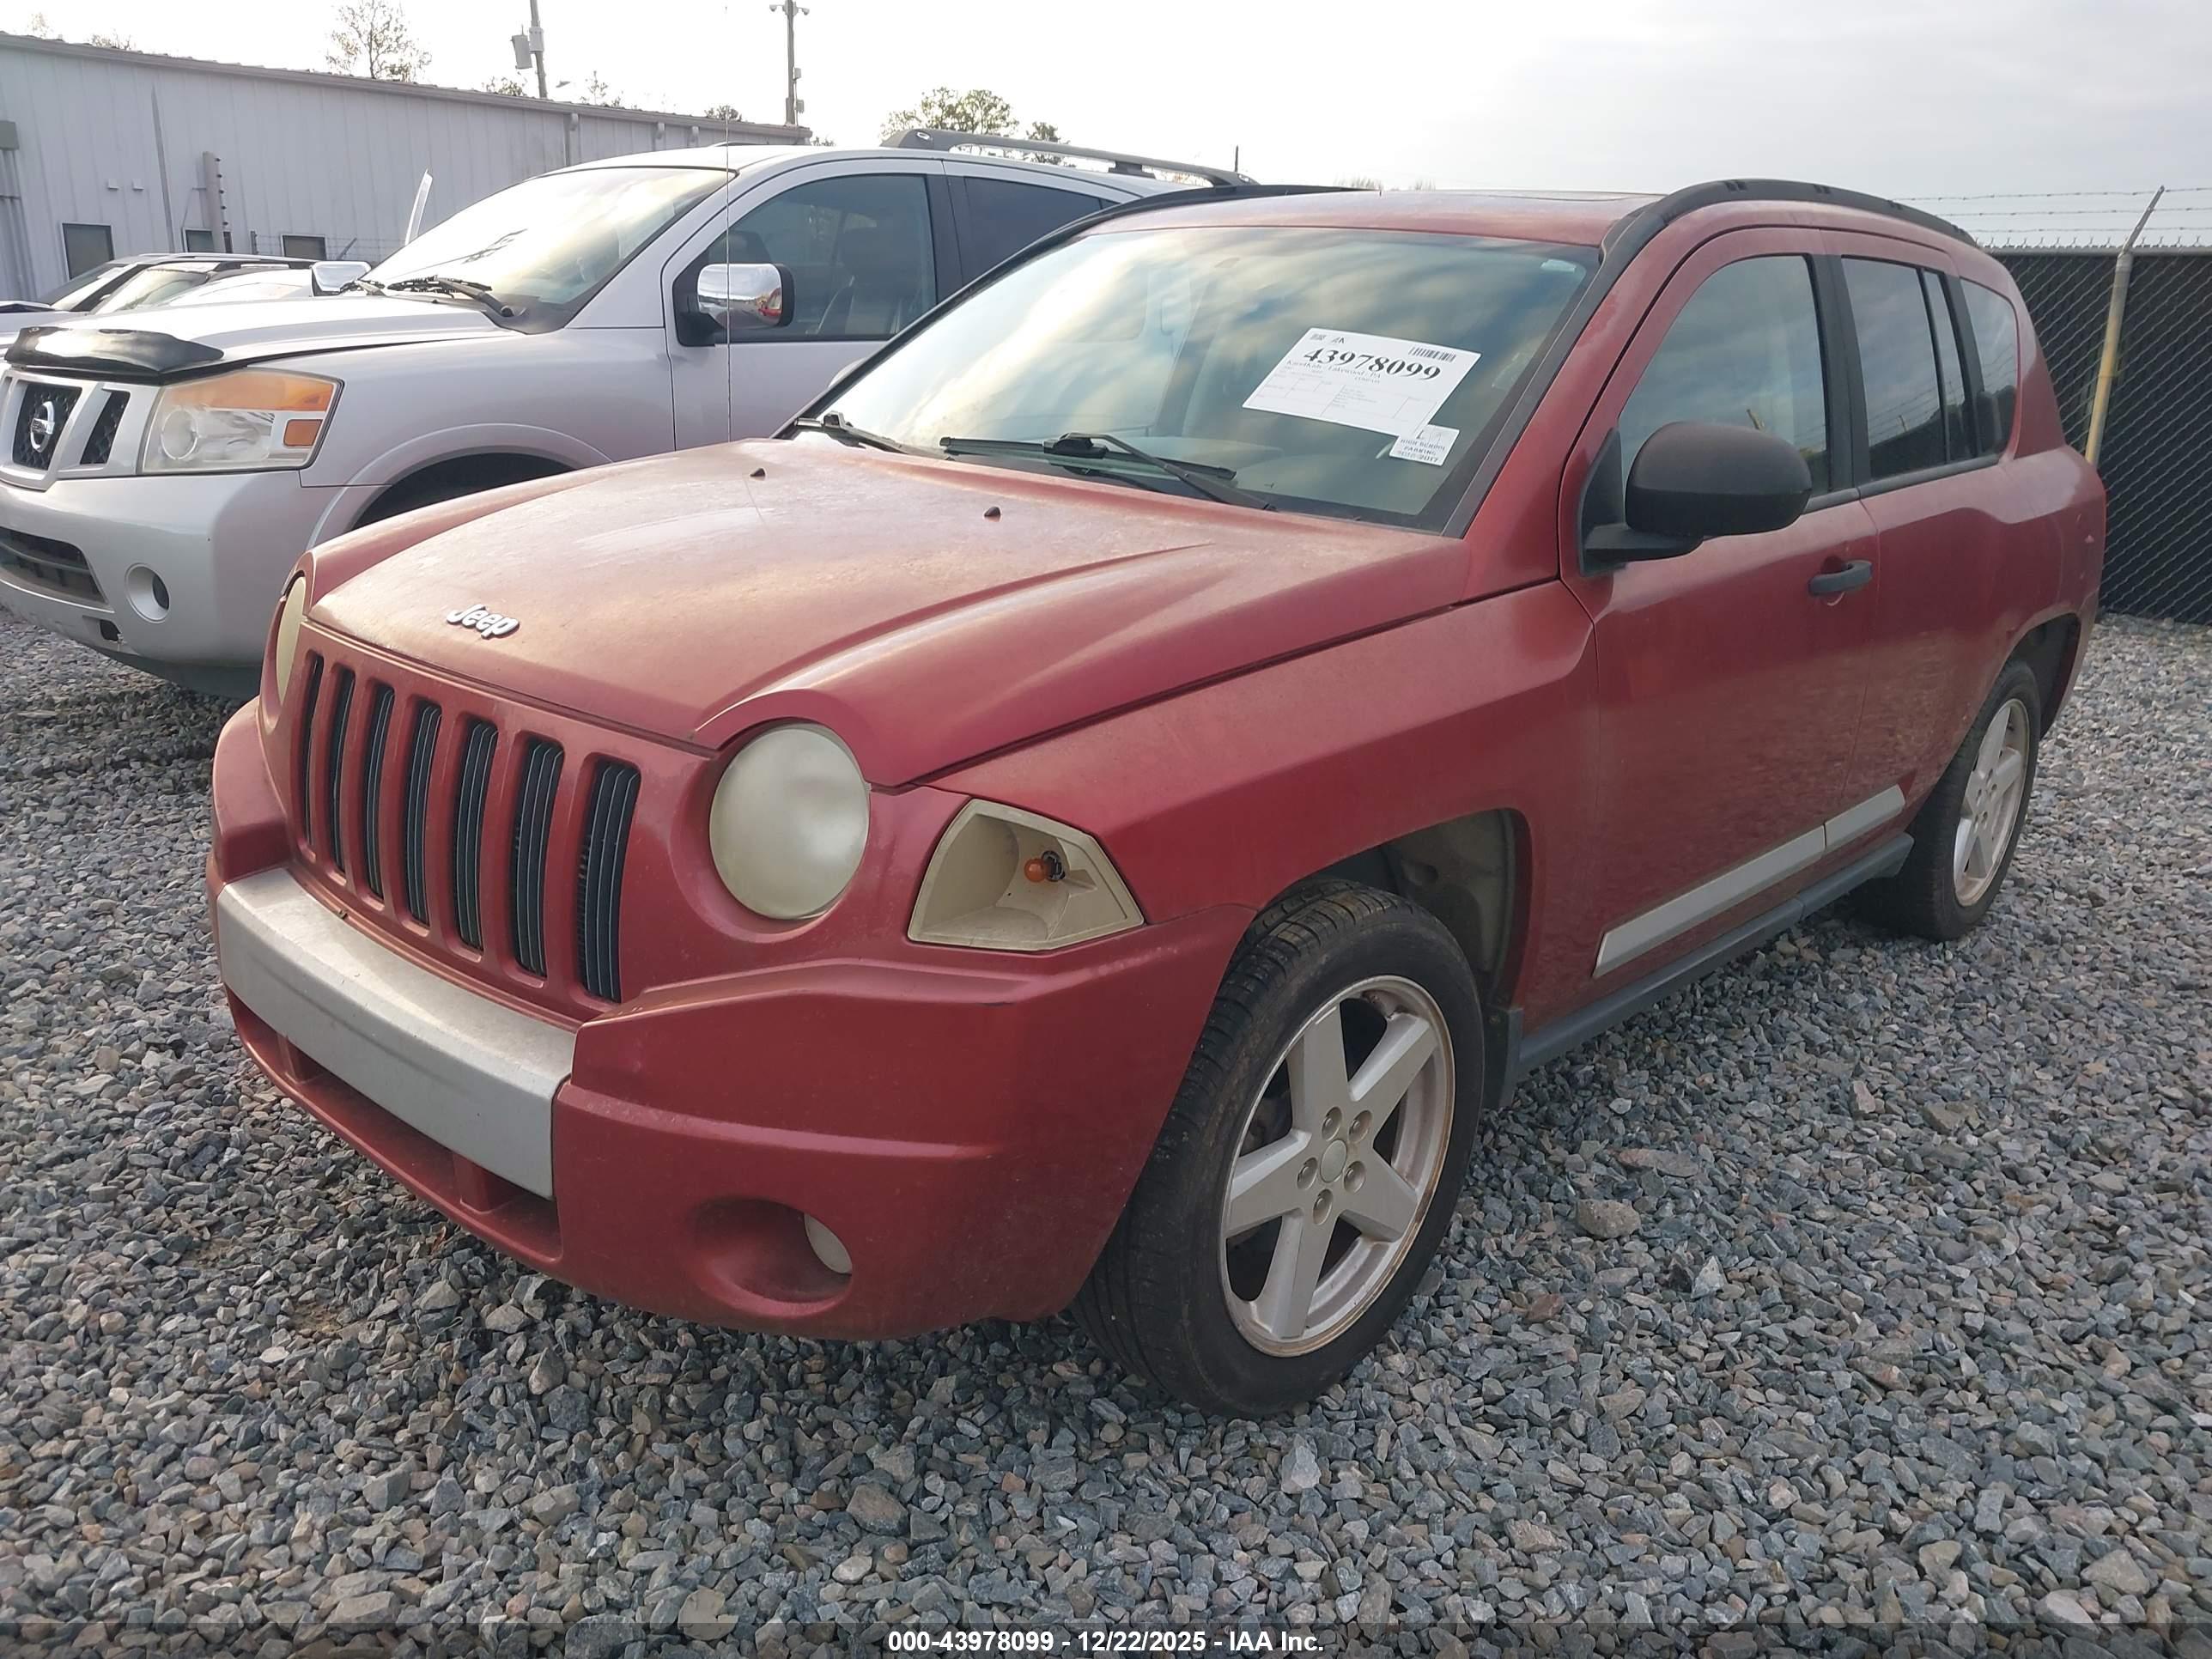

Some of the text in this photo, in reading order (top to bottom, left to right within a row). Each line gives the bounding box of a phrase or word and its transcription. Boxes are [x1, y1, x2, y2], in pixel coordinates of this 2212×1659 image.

[1303, 347, 1442, 381] 43978099
[1404, 446, 1437, 456] PARKING
[446, 603, 520, 640] Jeep
